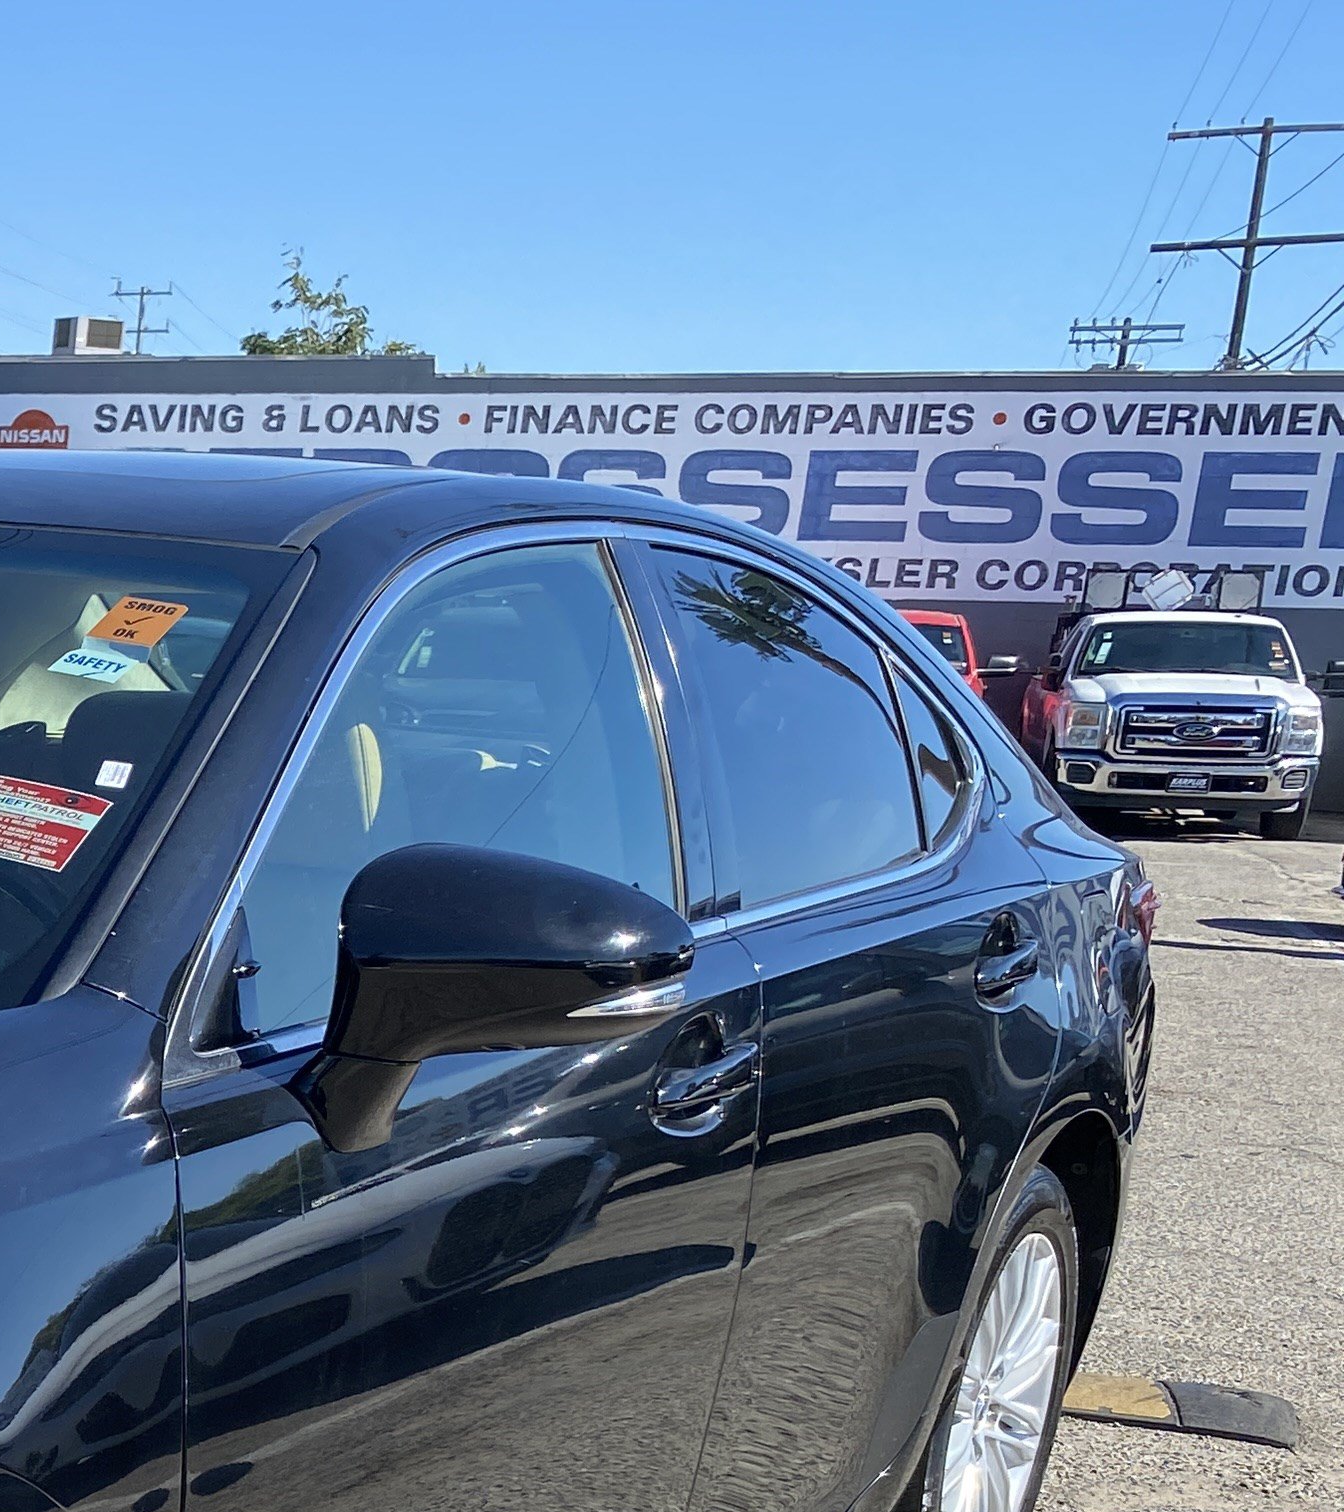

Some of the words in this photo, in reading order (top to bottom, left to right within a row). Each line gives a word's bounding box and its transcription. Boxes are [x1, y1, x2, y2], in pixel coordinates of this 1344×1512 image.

[93, 403, 244, 433] SAVING
[262, 404, 287, 432] &
[299, 404, 441, 434] LOANS
[483, 404, 679, 435] FINANCE
[693, 403, 975, 435] COMPANIES
[0, 429, 66, 443] NISSAN
[821, 556, 960, 590] SLER
[123, 600, 178, 616] SMOG
[112, 628, 139, 640] OK
[63, 653, 128, 674] SAFETY
[15, 786, 40, 796] Your
